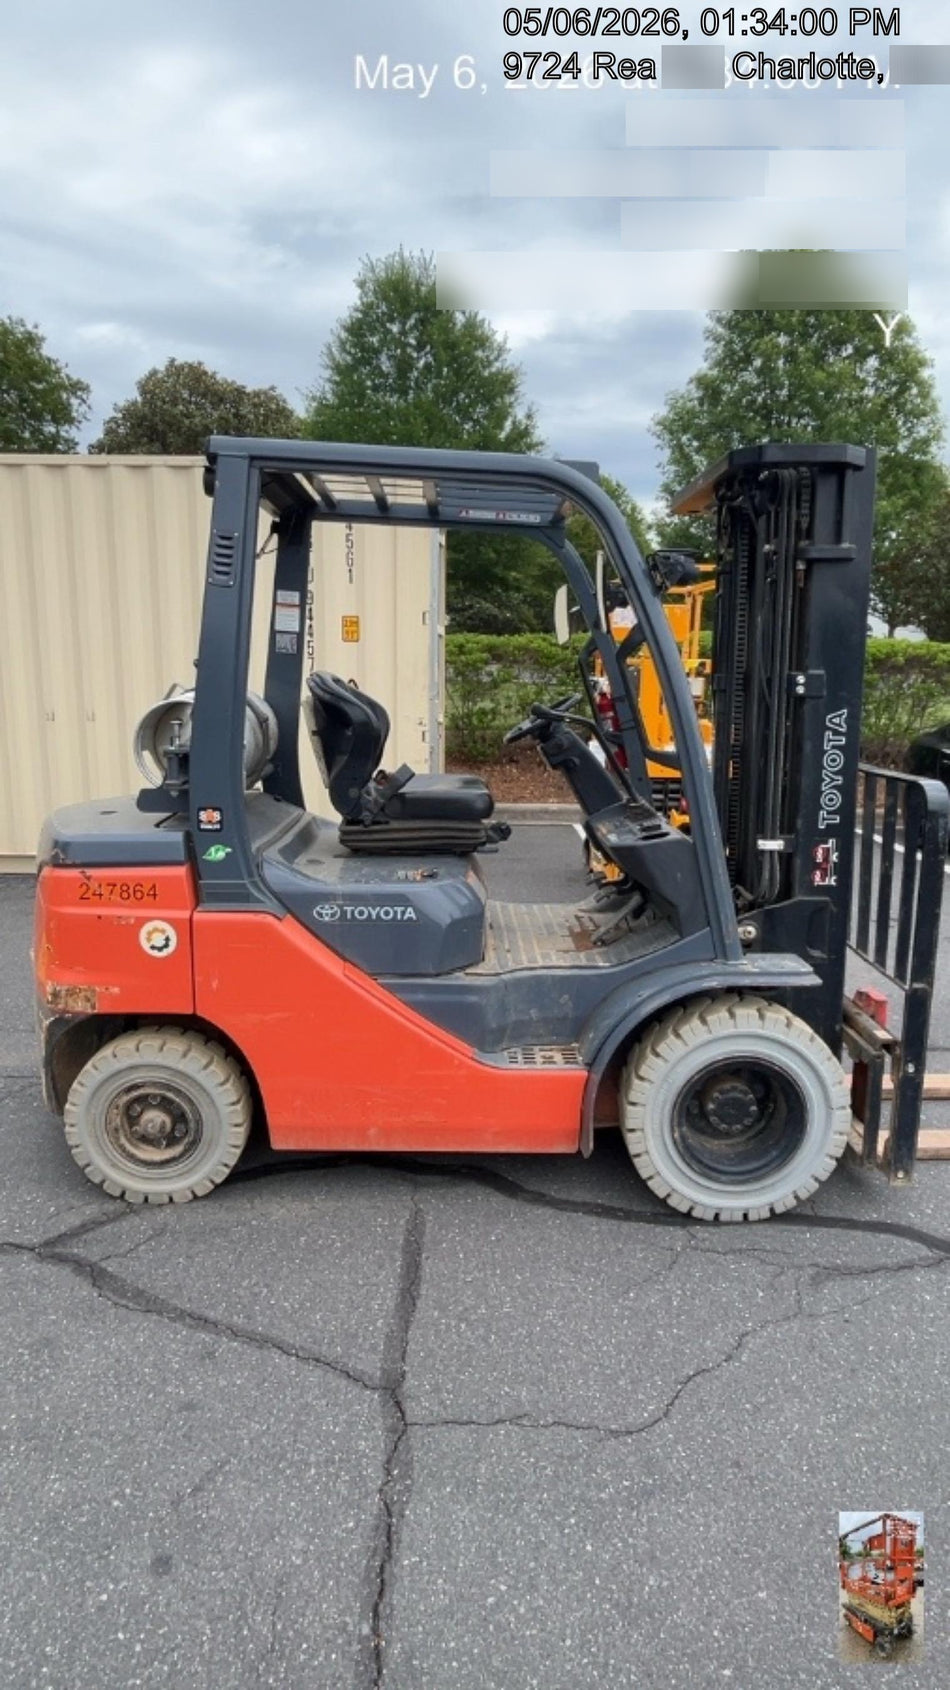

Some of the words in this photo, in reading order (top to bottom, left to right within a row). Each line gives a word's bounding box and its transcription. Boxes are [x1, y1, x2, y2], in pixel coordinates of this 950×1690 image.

[817, 709, 848, 829] TOYOTA
[78, 881, 158, 901] 247864
[343, 906, 417, 920] TOYOTA
